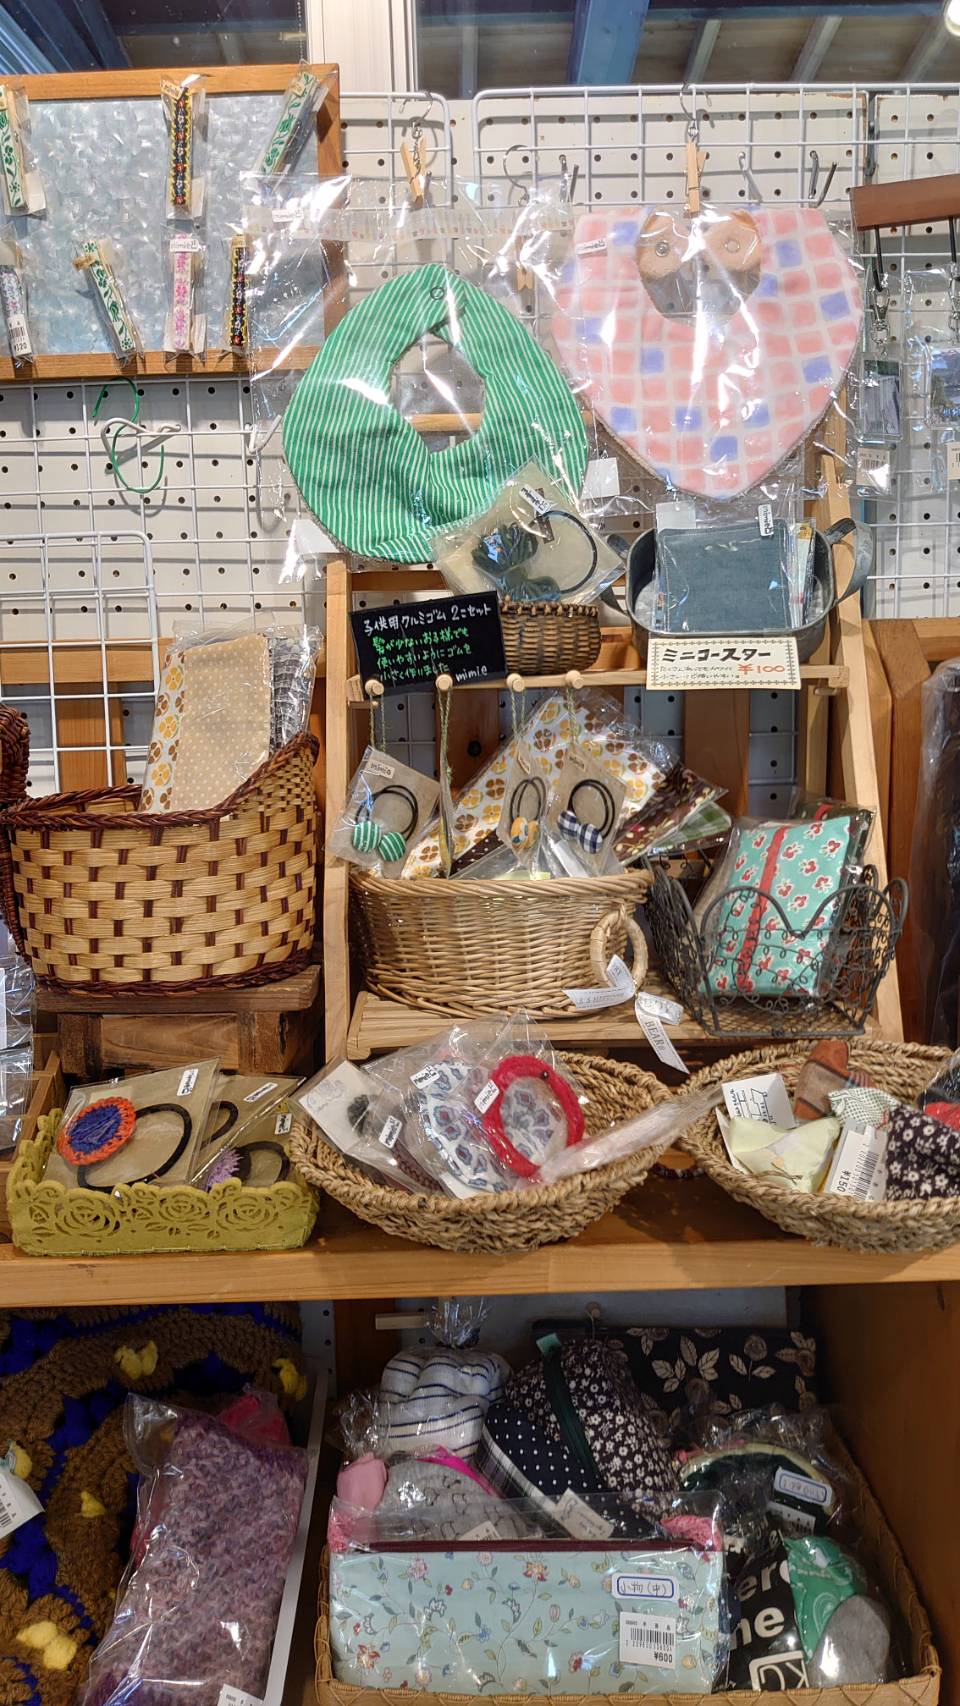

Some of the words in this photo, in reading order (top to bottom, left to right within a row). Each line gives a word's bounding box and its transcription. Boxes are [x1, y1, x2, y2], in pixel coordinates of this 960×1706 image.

[662, 648, 771, 662] ミニコースター
[455, 665, 488, 683] mimie
[738, 663, 785, 675] ¥100
[837, 1170, 851, 1193] ¥150
[654, 1651, 673, 1664] ¥600
